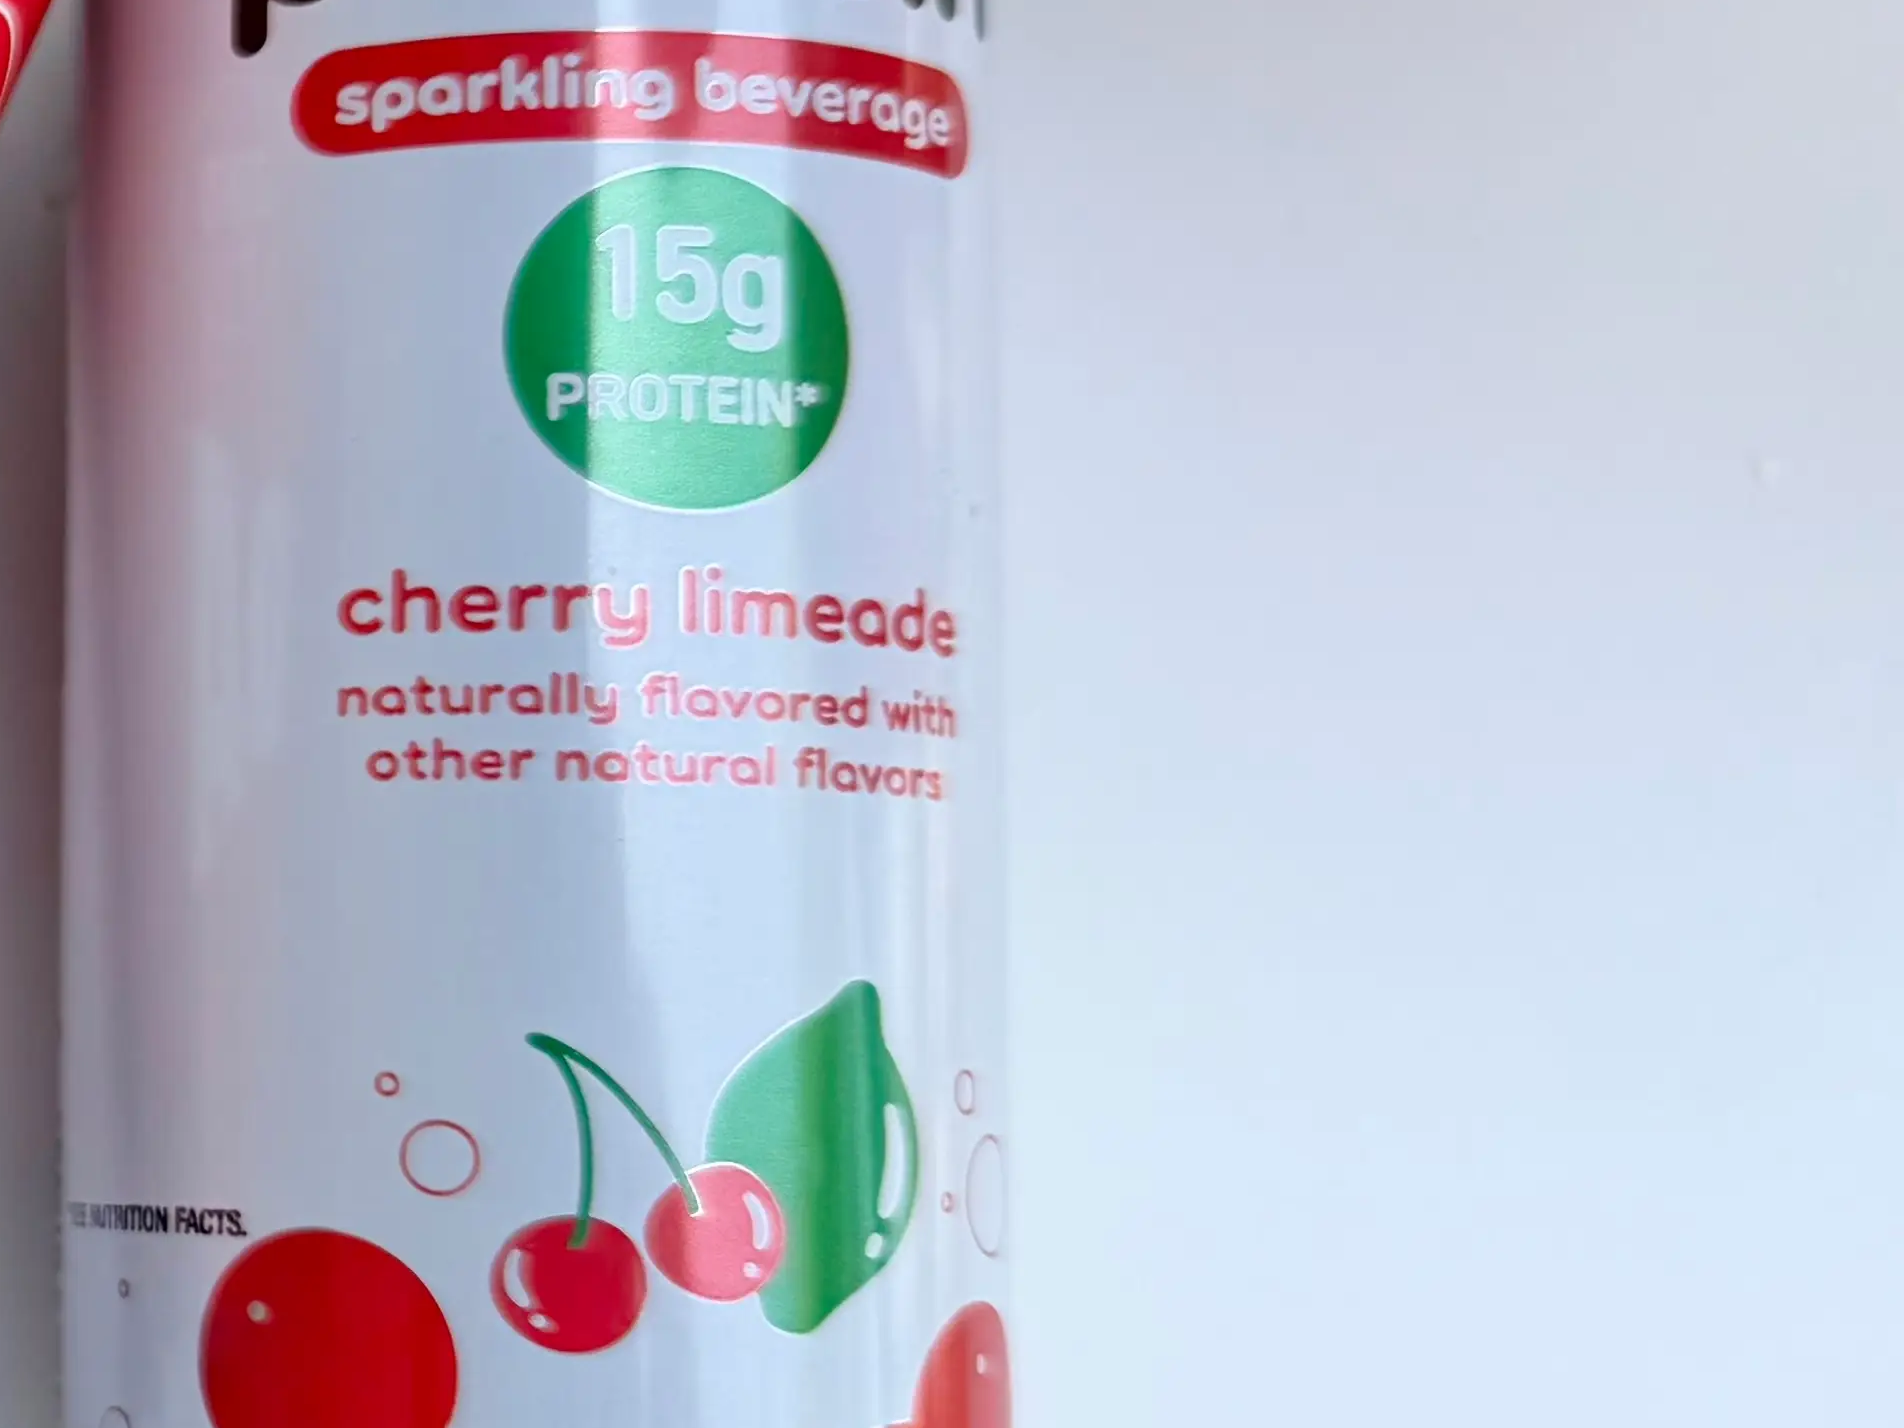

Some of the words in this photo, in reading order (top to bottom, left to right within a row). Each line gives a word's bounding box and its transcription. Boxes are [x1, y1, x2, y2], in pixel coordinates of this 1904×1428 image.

[335, 53, 675, 132] sparkling
[694, 56, 955, 149] beverage
[594, 223, 786, 354] 15g
[337, 569, 651, 649] cherry
[678, 565, 959, 659] limeade
[337, 672, 619, 726] naturally
[642, 673, 869, 730] flavored
[881, 688, 959, 740] with
[365, 739, 536, 783] other
[555, 745, 777, 790] natural
[793, 748, 945, 802] flavors
[173, 1205, 248, 1237] FACTS.
